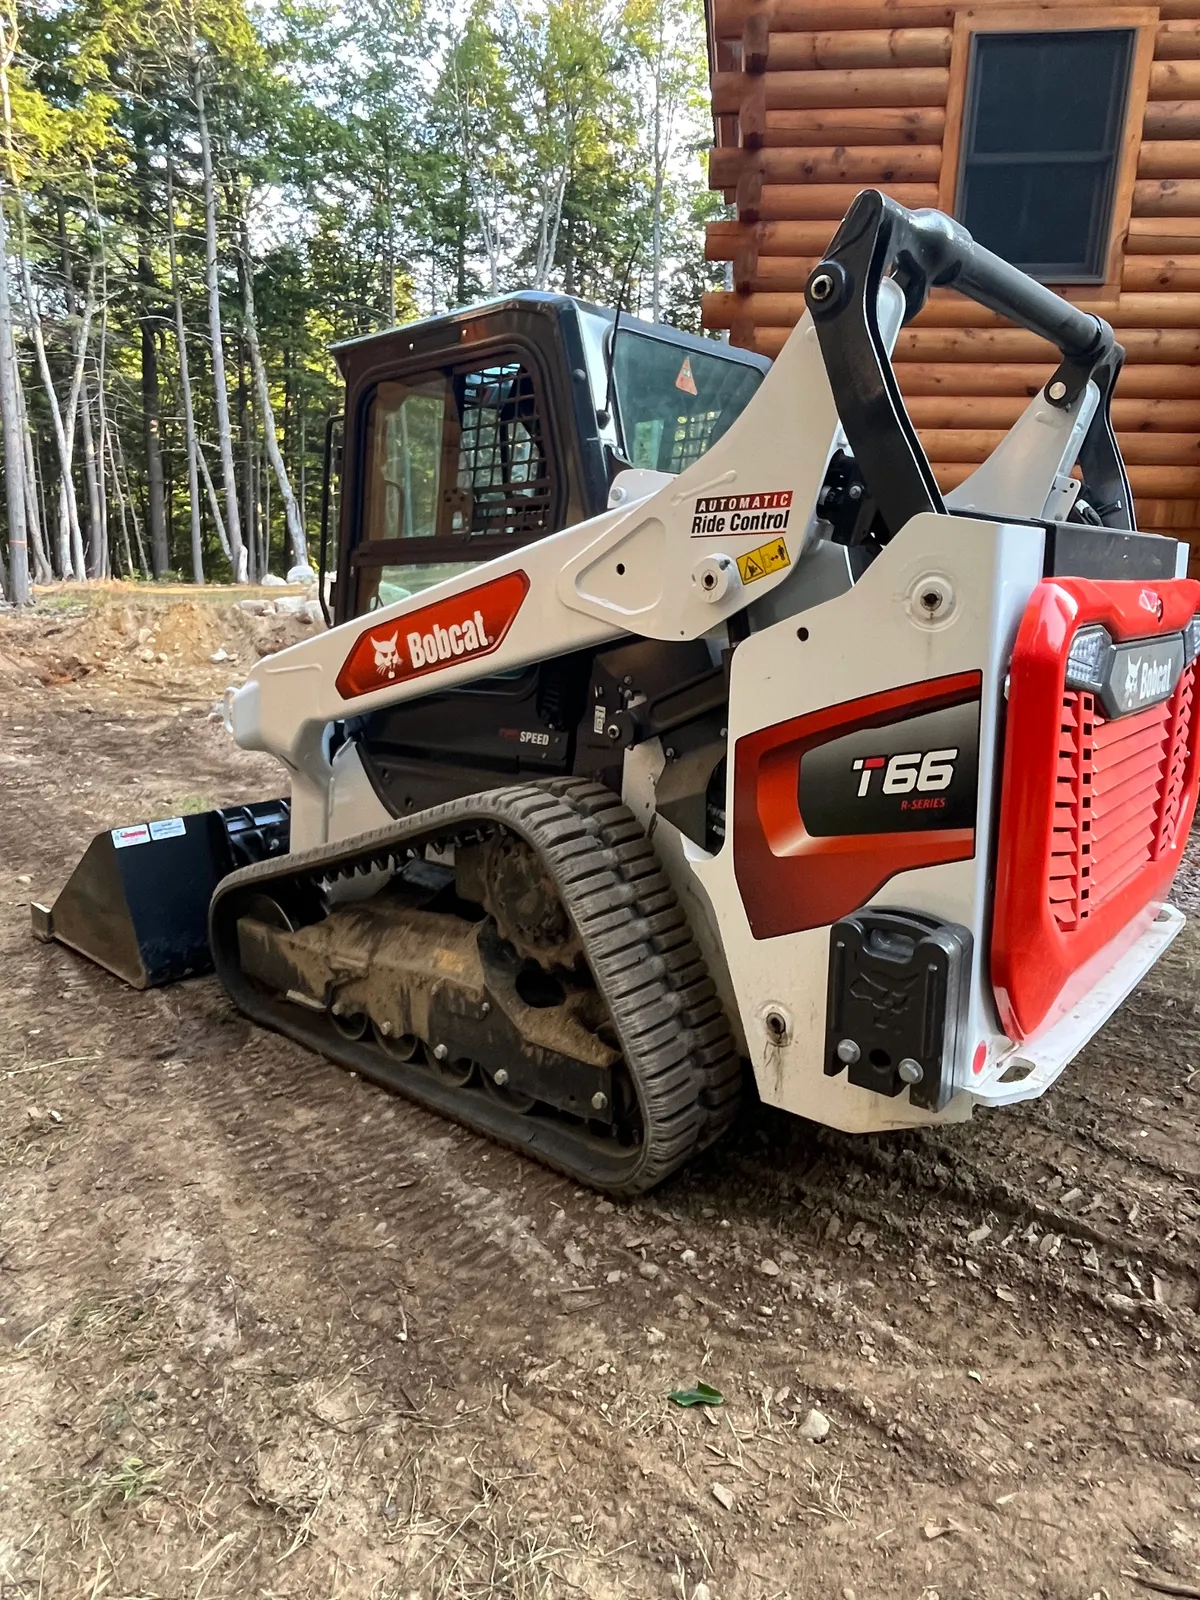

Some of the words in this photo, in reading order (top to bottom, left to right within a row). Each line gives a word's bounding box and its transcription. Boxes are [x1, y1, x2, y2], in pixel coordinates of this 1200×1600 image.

[698, 494, 789, 512] AUTOMATIC
[691, 515, 725, 533] Ride
[730, 510, 790, 531] Control
[407, 610, 488, 669] Bobcat
[1139, 658, 1172, 700] Bobcat
[520, 731, 549, 745] SPEED
[853, 749, 958, 797] T66
[901, 798, 946, 810] R-SERIES
